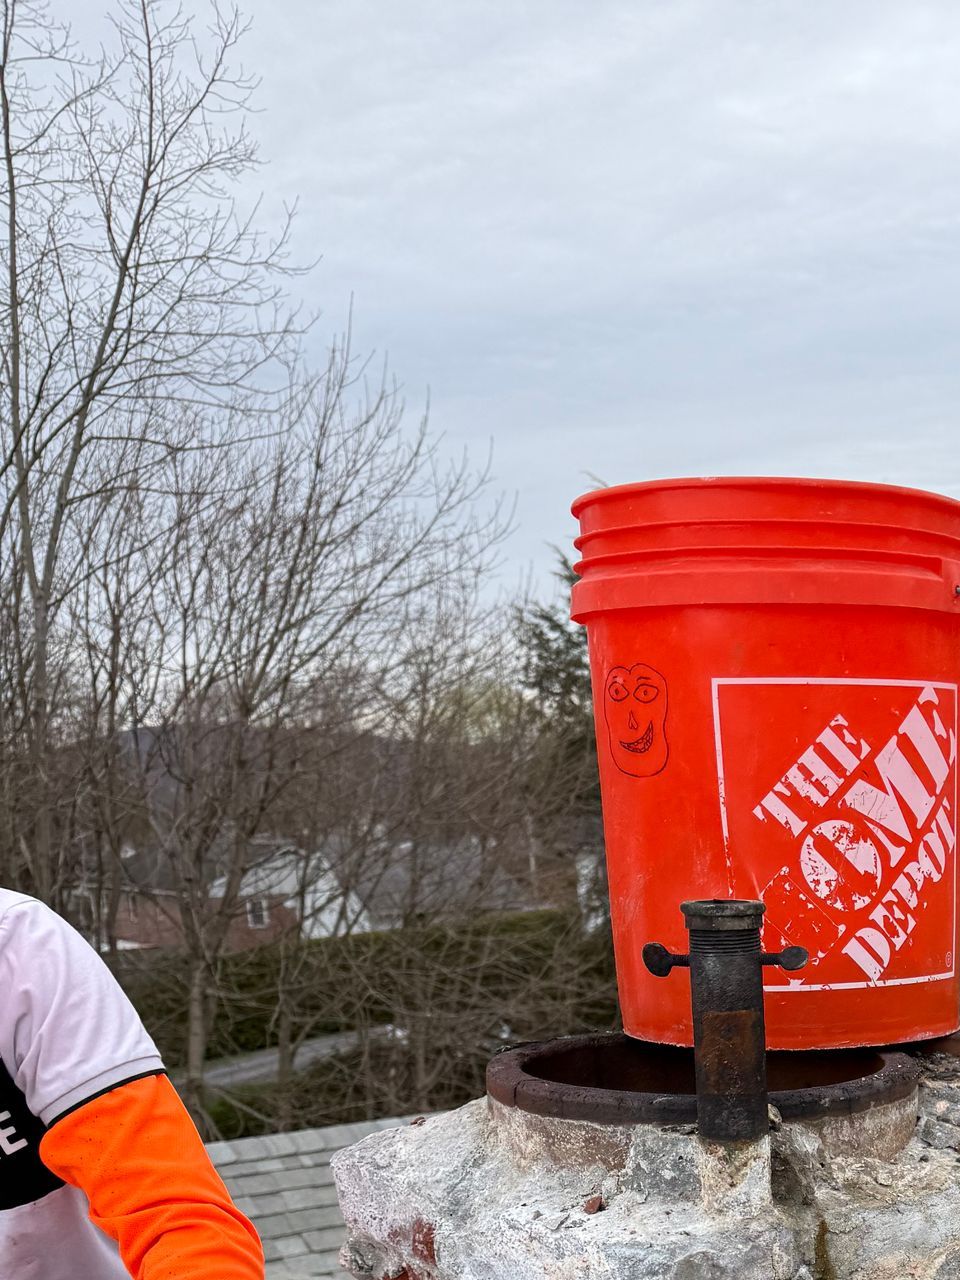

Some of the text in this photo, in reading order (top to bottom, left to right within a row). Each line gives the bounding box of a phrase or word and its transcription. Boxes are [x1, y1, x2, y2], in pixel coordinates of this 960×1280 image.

[752, 713, 872, 838] THE
[761, 686, 956, 985] OME
[842, 797, 955, 980] DEPOT
